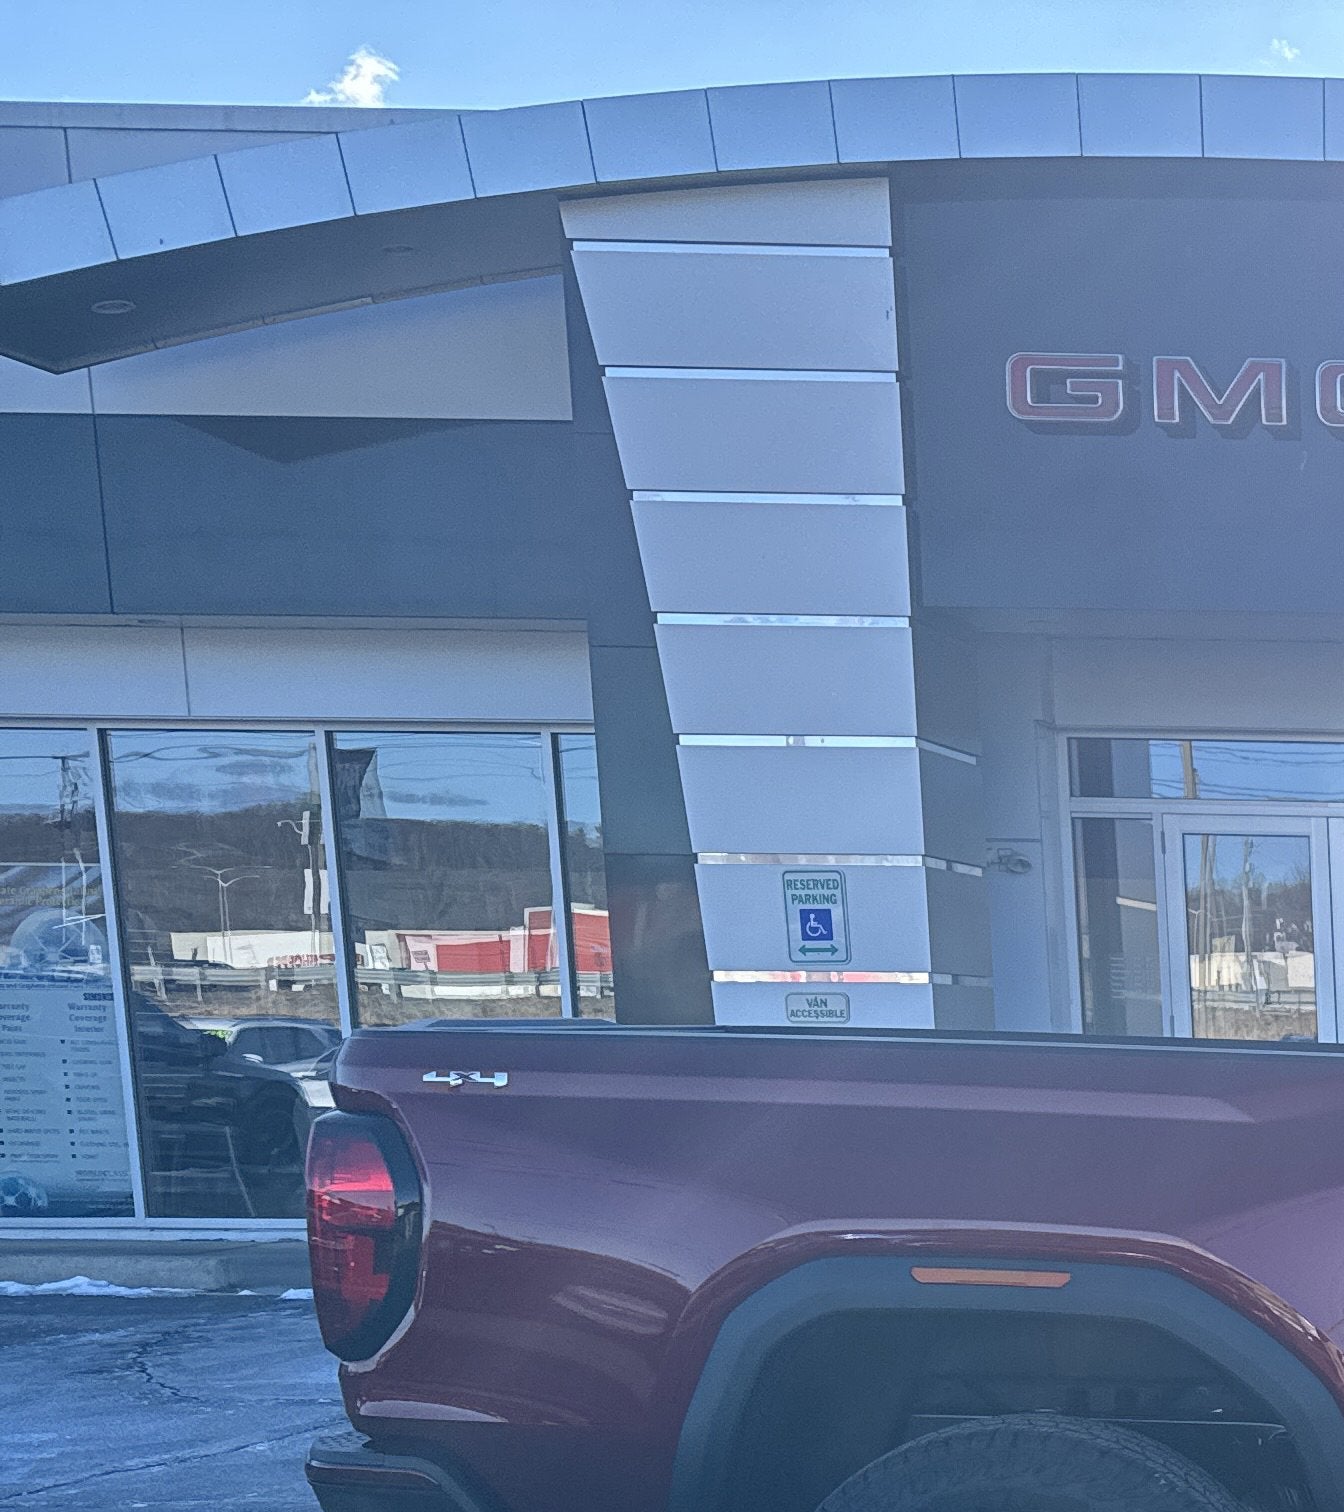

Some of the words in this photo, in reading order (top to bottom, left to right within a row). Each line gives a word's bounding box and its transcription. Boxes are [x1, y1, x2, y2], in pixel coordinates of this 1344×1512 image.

[786, 878, 840, 891] RESERVED
[791, 893, 837, 905] PARKING
[67, 1002, 107, 1013] Warranty
[806, 997, 828, 1009] VAN
[789, 1009, 846, 1019] ACCESSIBLE
